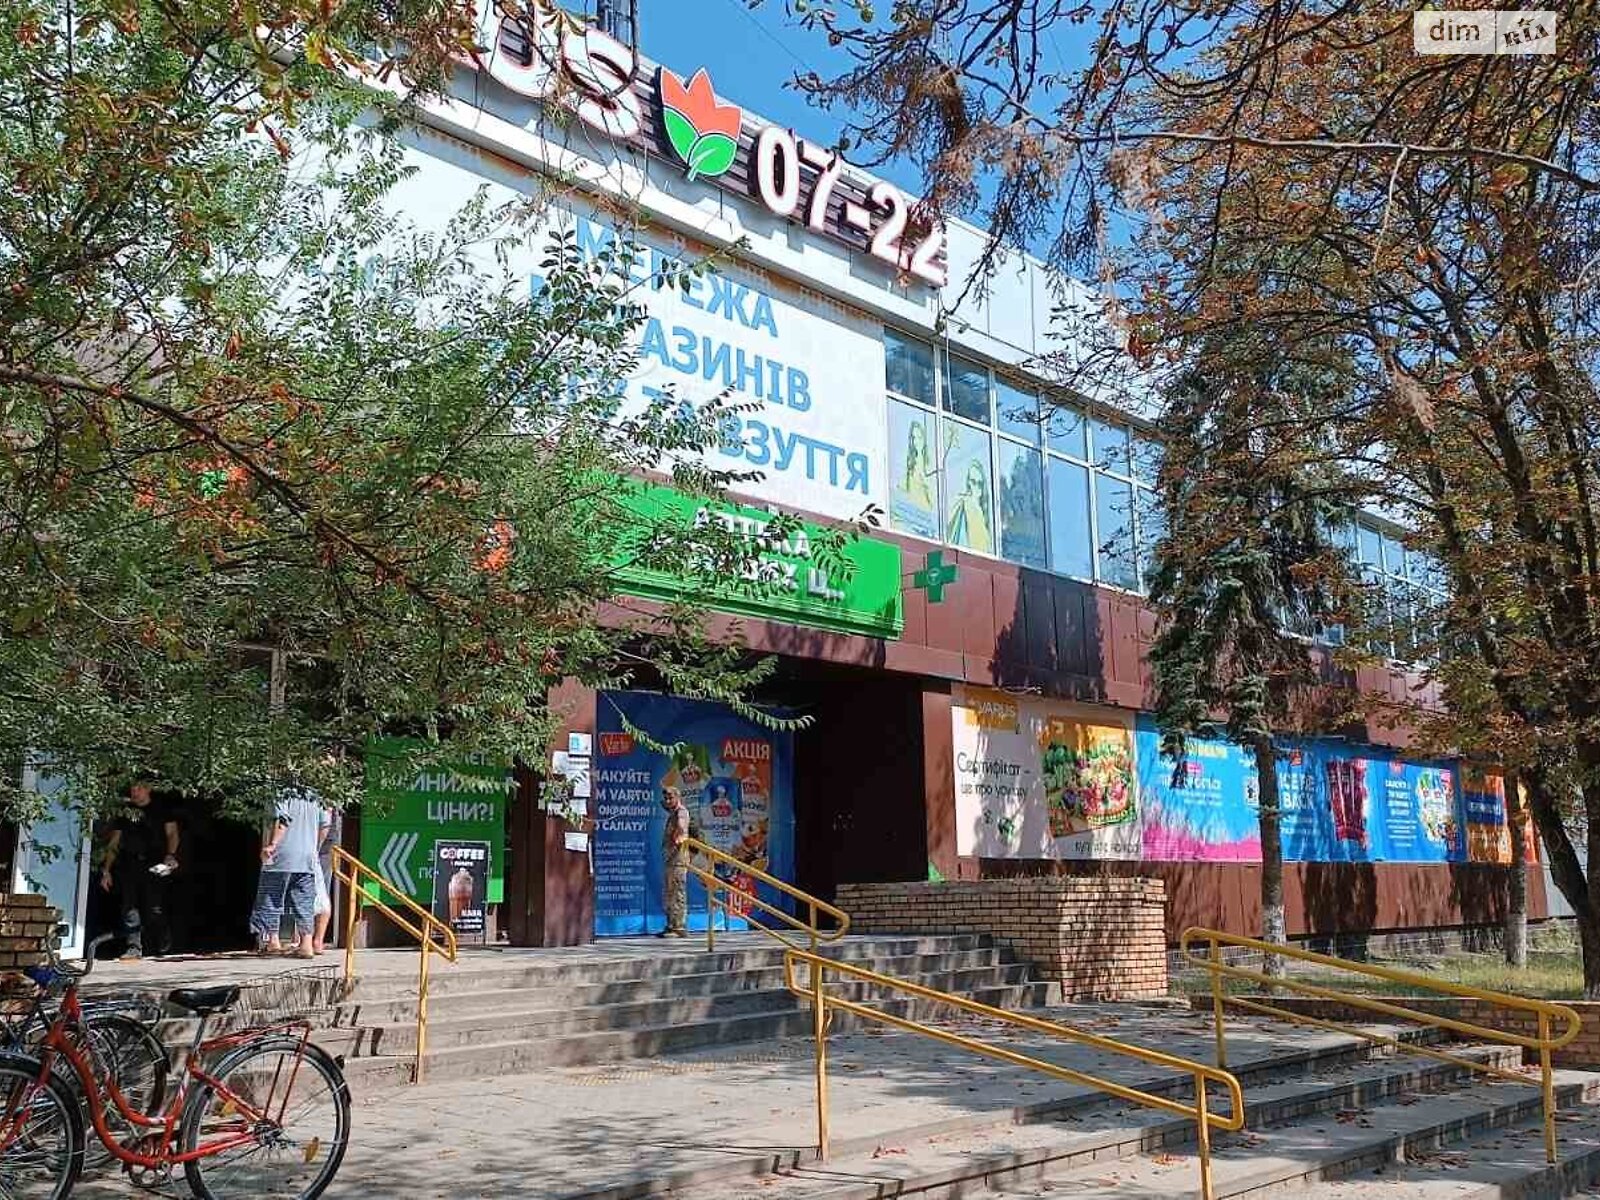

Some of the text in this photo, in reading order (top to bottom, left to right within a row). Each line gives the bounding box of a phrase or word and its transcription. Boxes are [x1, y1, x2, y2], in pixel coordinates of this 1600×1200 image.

[756, 125, 947, 288] 07-22
[724, 740, 770, 763] АКЦІЯ
[427, 801, 495, 824] ЦІНИ?!
